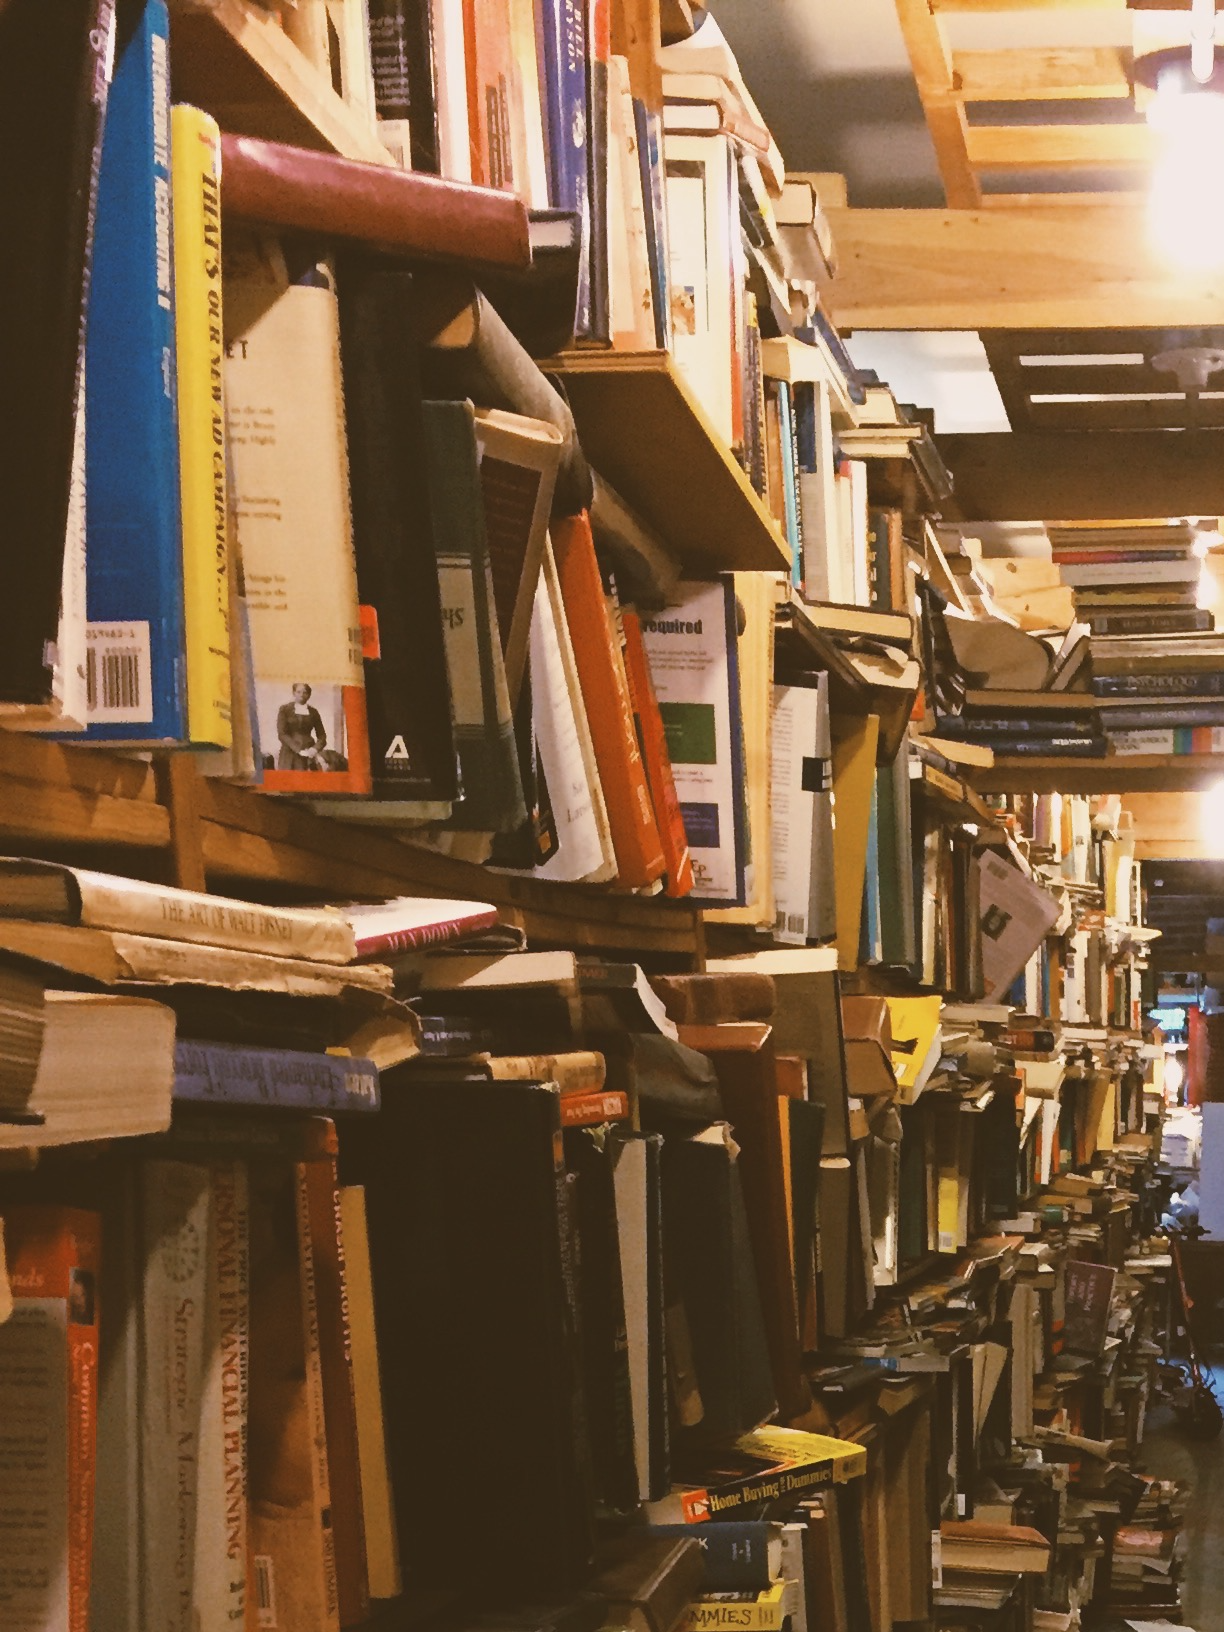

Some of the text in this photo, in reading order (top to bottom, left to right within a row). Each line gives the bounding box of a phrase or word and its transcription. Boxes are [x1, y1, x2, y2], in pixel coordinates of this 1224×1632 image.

[575, 8, 584, 60] BILL
[154, 176, 171, 293] ACCOUNTING
[201, 173, 219, 280] THAT'S
[207, 289, 221, 344] OUR
[209, 355, 222, 403] NEW
[211, 411, 223, 446] AD
[643, 619, 703, 637] required
[162, 902, 184, 922] THE
[189, 903, 210, 929] ART
[219, 1290, 241, 1425] FINANCIAL
[225, 1430, 242, 1560] PLANNING
[710, 1493, 742, 1513] Home
[742, 1481, 780, 1501] Buying
[786, 1467, 833, 1492] Dummies
